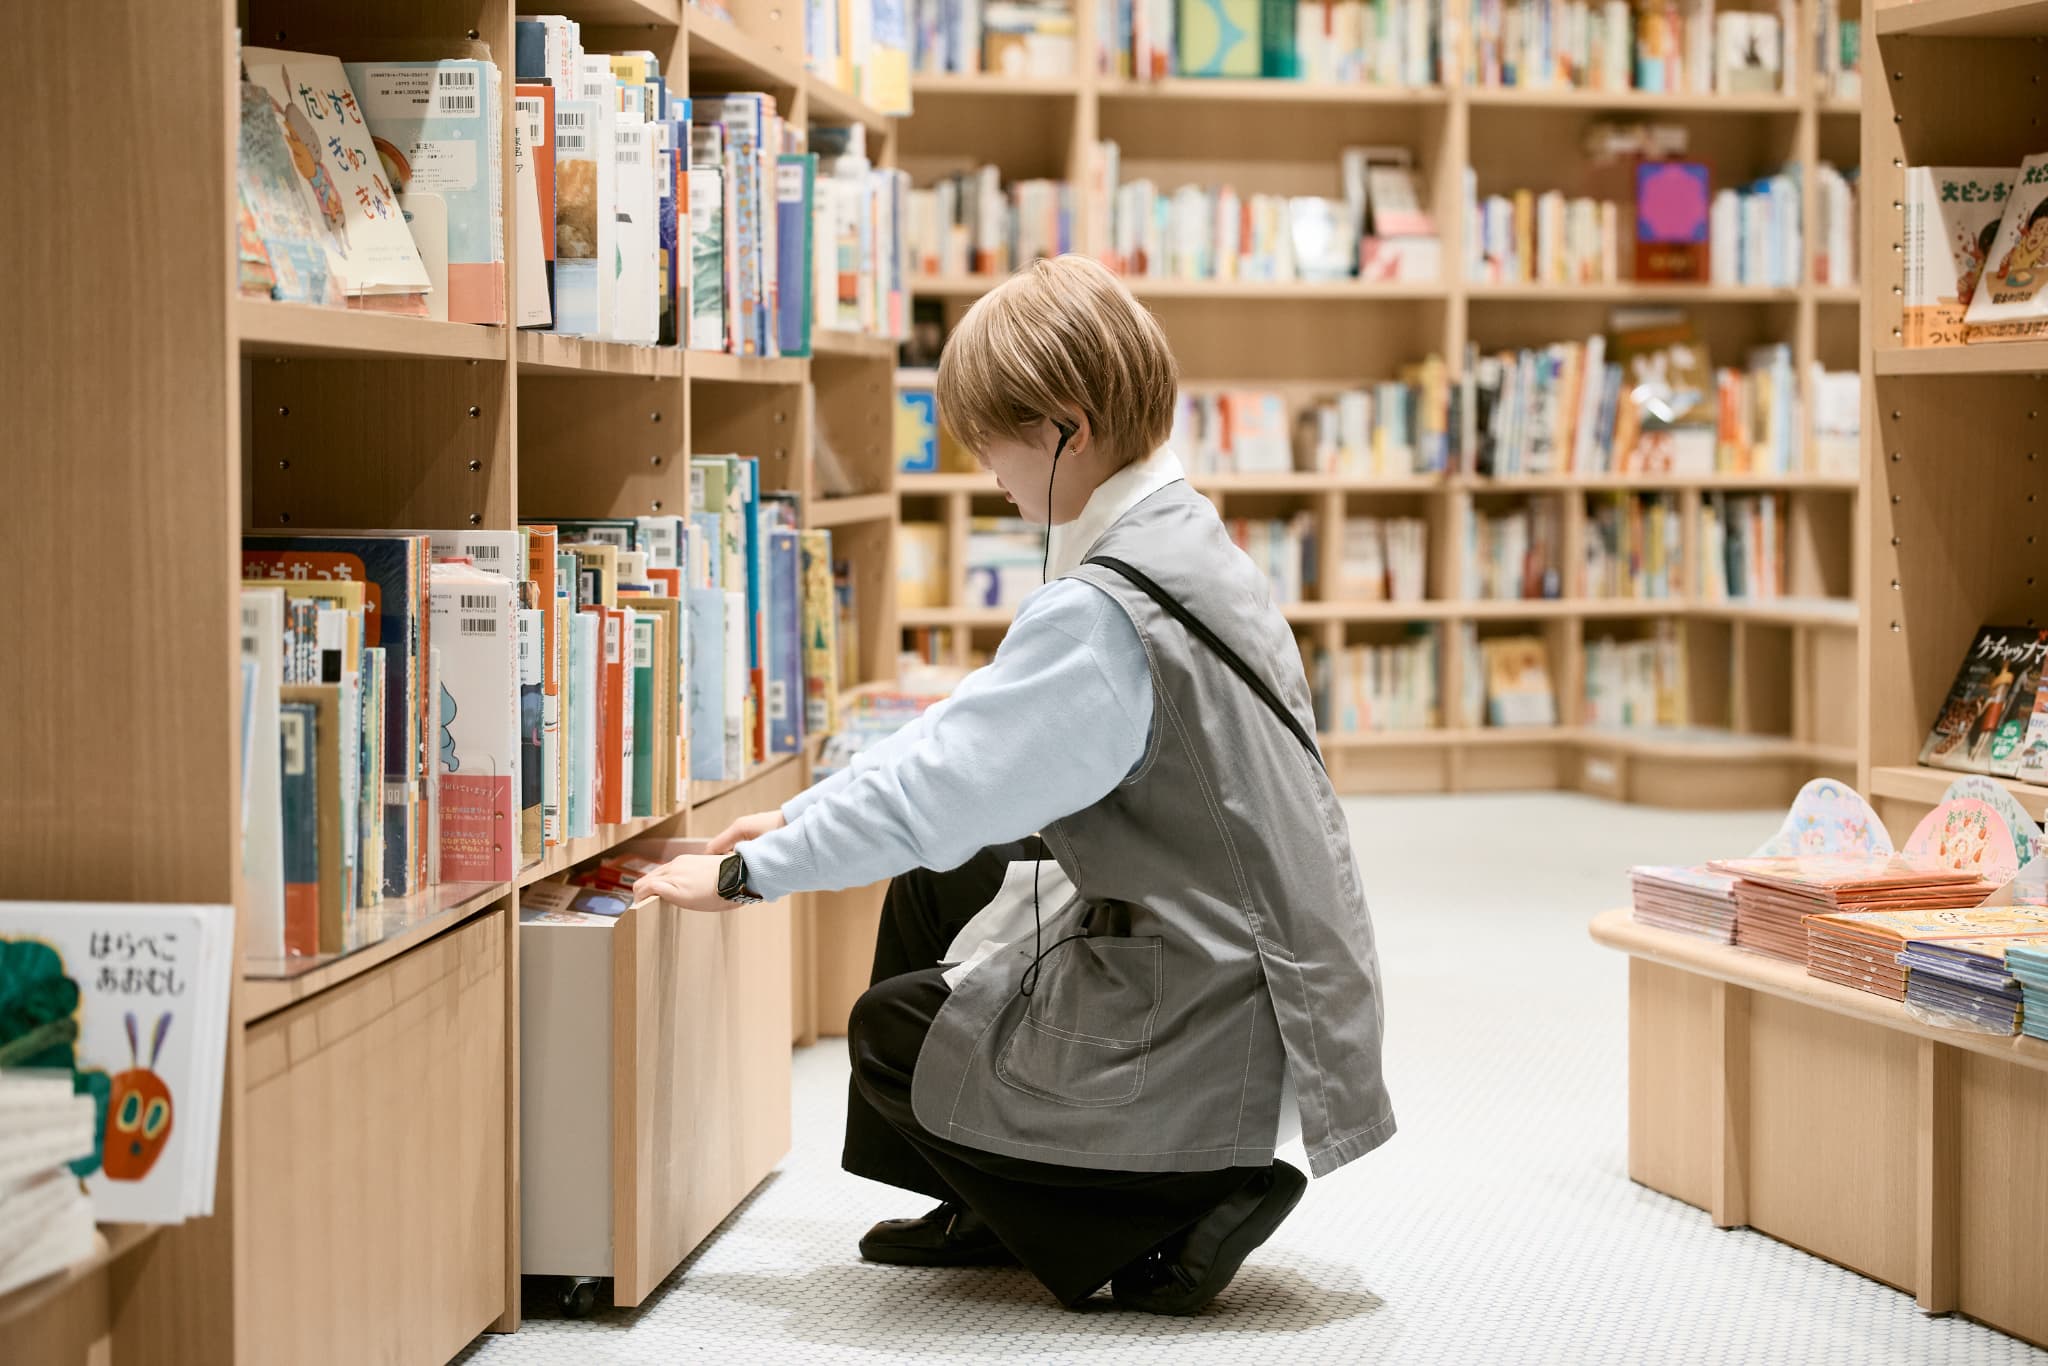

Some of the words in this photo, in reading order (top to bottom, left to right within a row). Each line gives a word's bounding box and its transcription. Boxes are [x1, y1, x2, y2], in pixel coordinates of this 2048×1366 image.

[299, 83, 362, 125] だいすき
[328, 136, 367, 172] ぎゅっ
[1942, 181, 2014, 202] 大ピンチ
[90, 931, 177, 960] はらぺこ
[96, 967, 185, 996] あおむし
